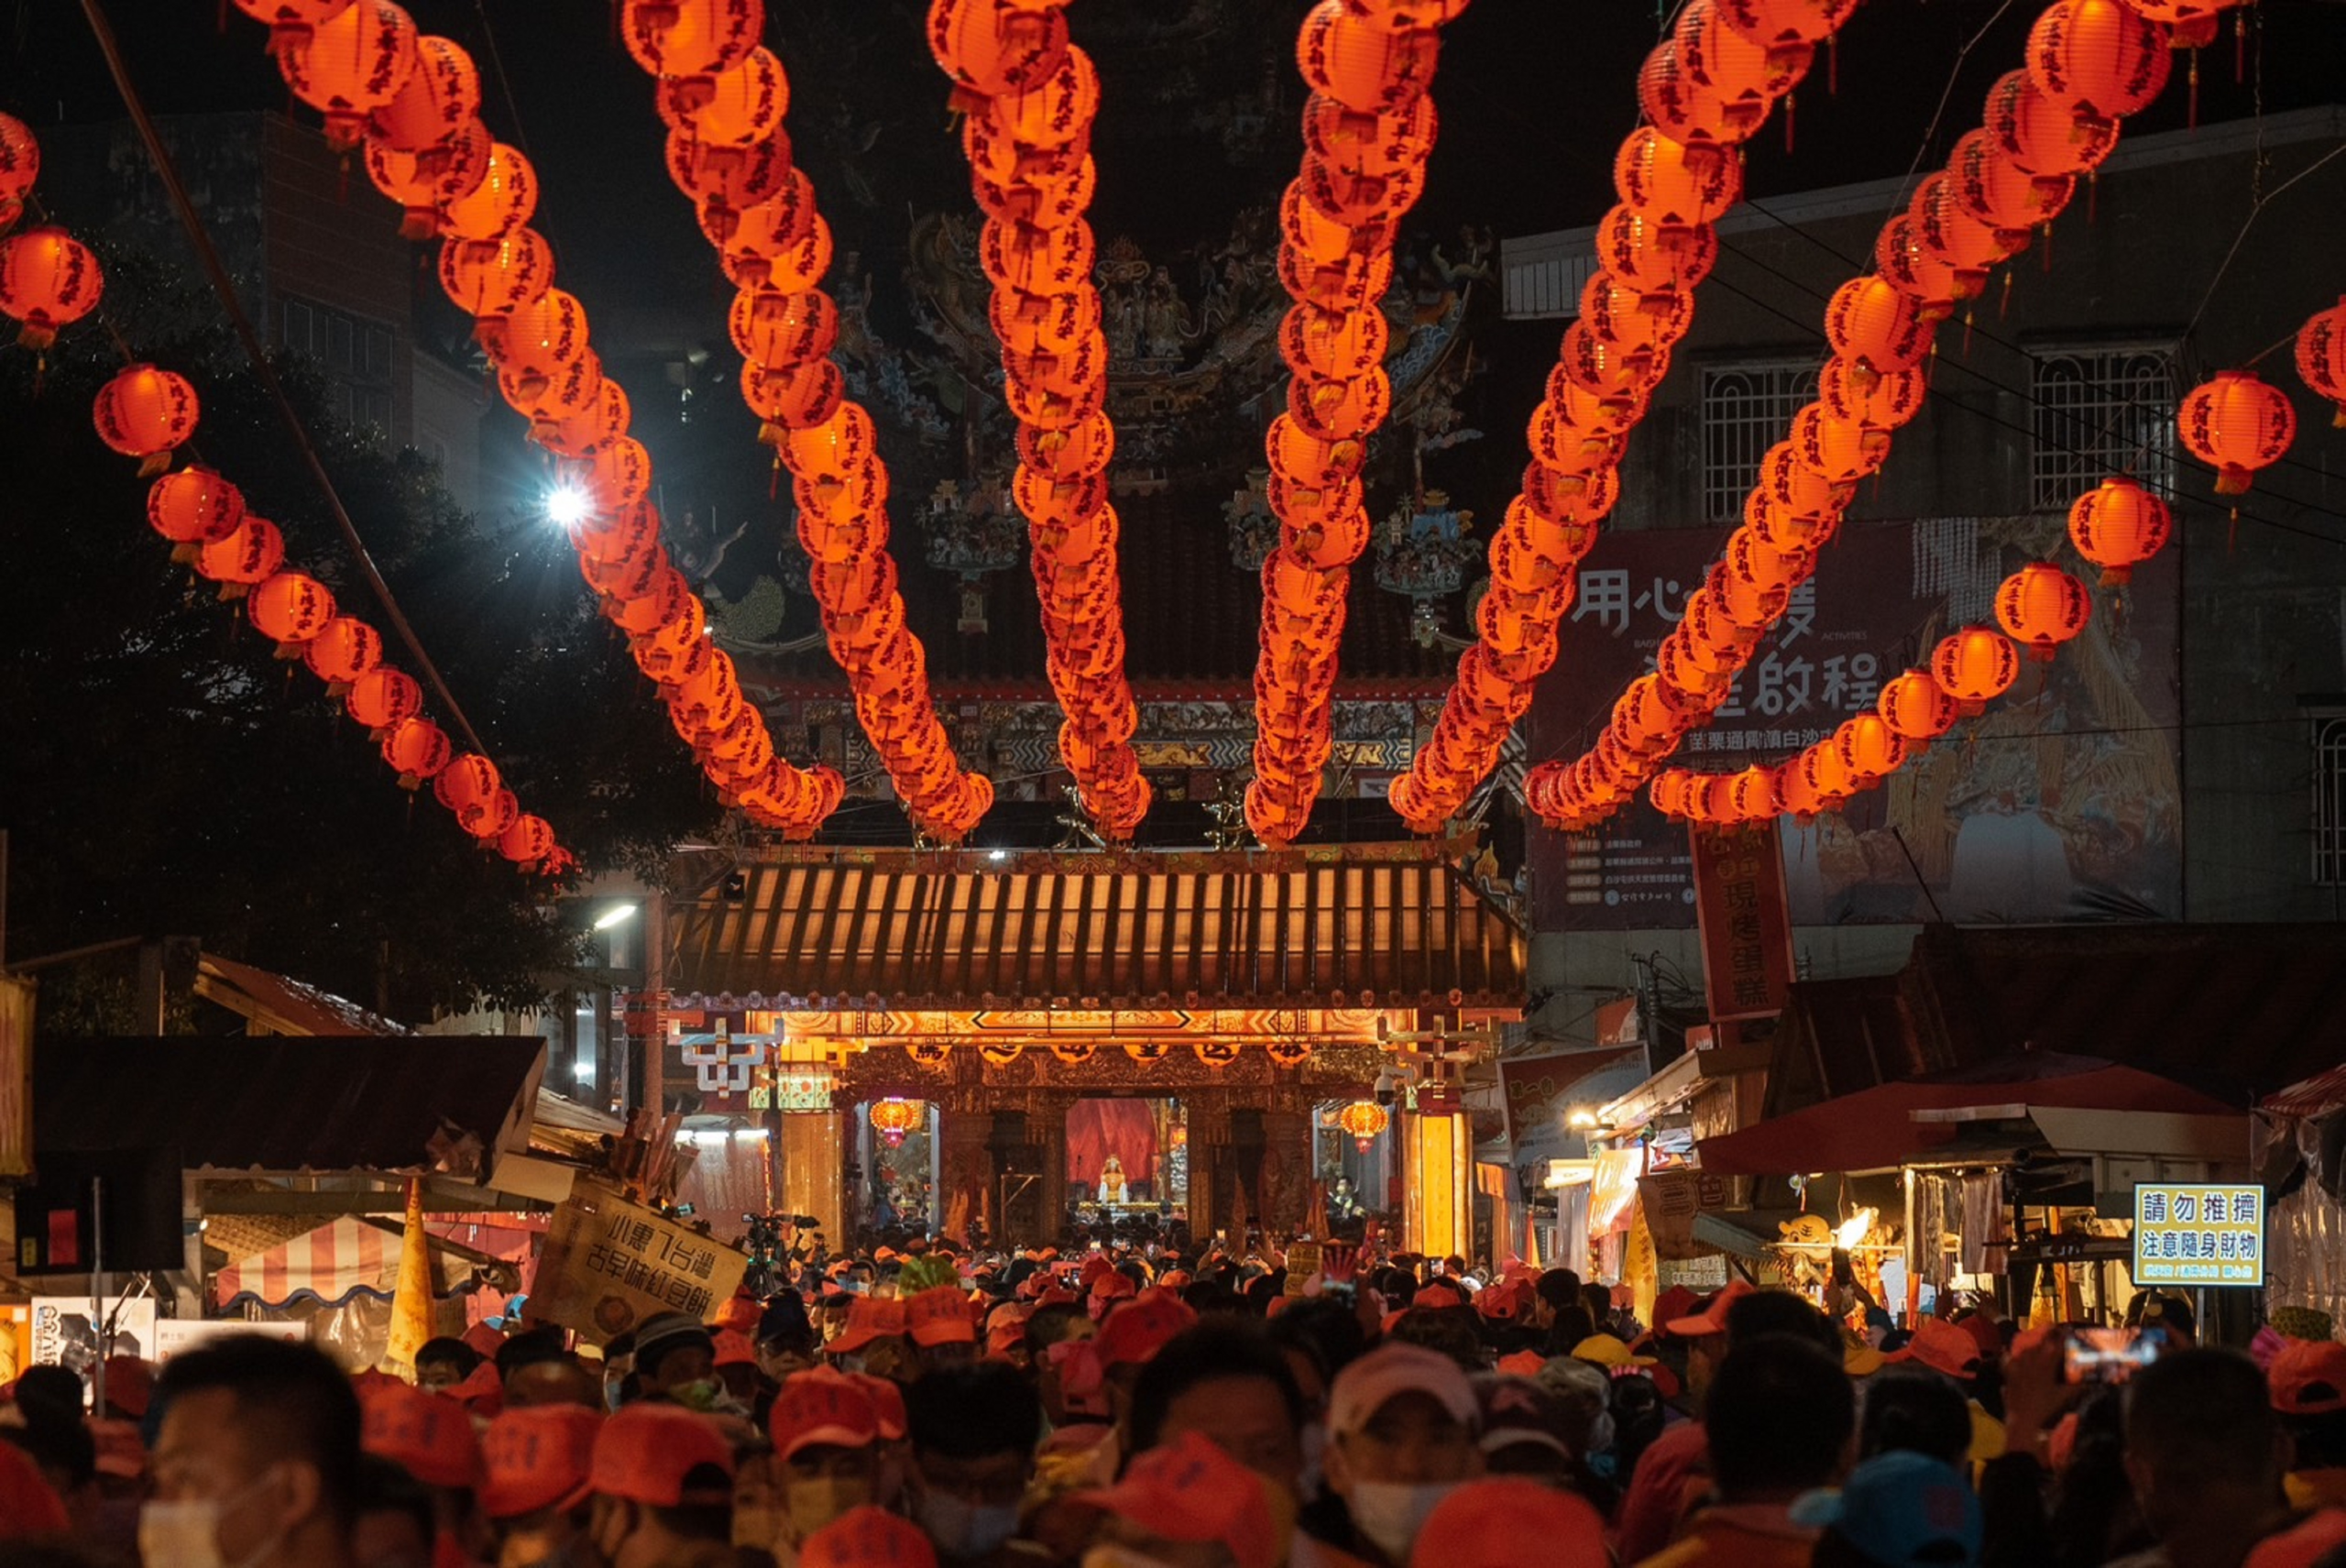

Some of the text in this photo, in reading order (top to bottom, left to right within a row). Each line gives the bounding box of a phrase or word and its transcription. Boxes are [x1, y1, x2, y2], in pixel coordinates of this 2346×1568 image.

[1571, 564, 1815, 649] 用心
[1822, 631, 1868, 641] ACTIVITIES
[1723, 881, 1770, 1006] 現烤蛋糕
[2143, 1193, 2257, 1223] 請勿推擠
[2143, 1232, 2257, 1259] 注意隨身財物
[586, 1244, 715, 1318] 古早味紅豆餅
